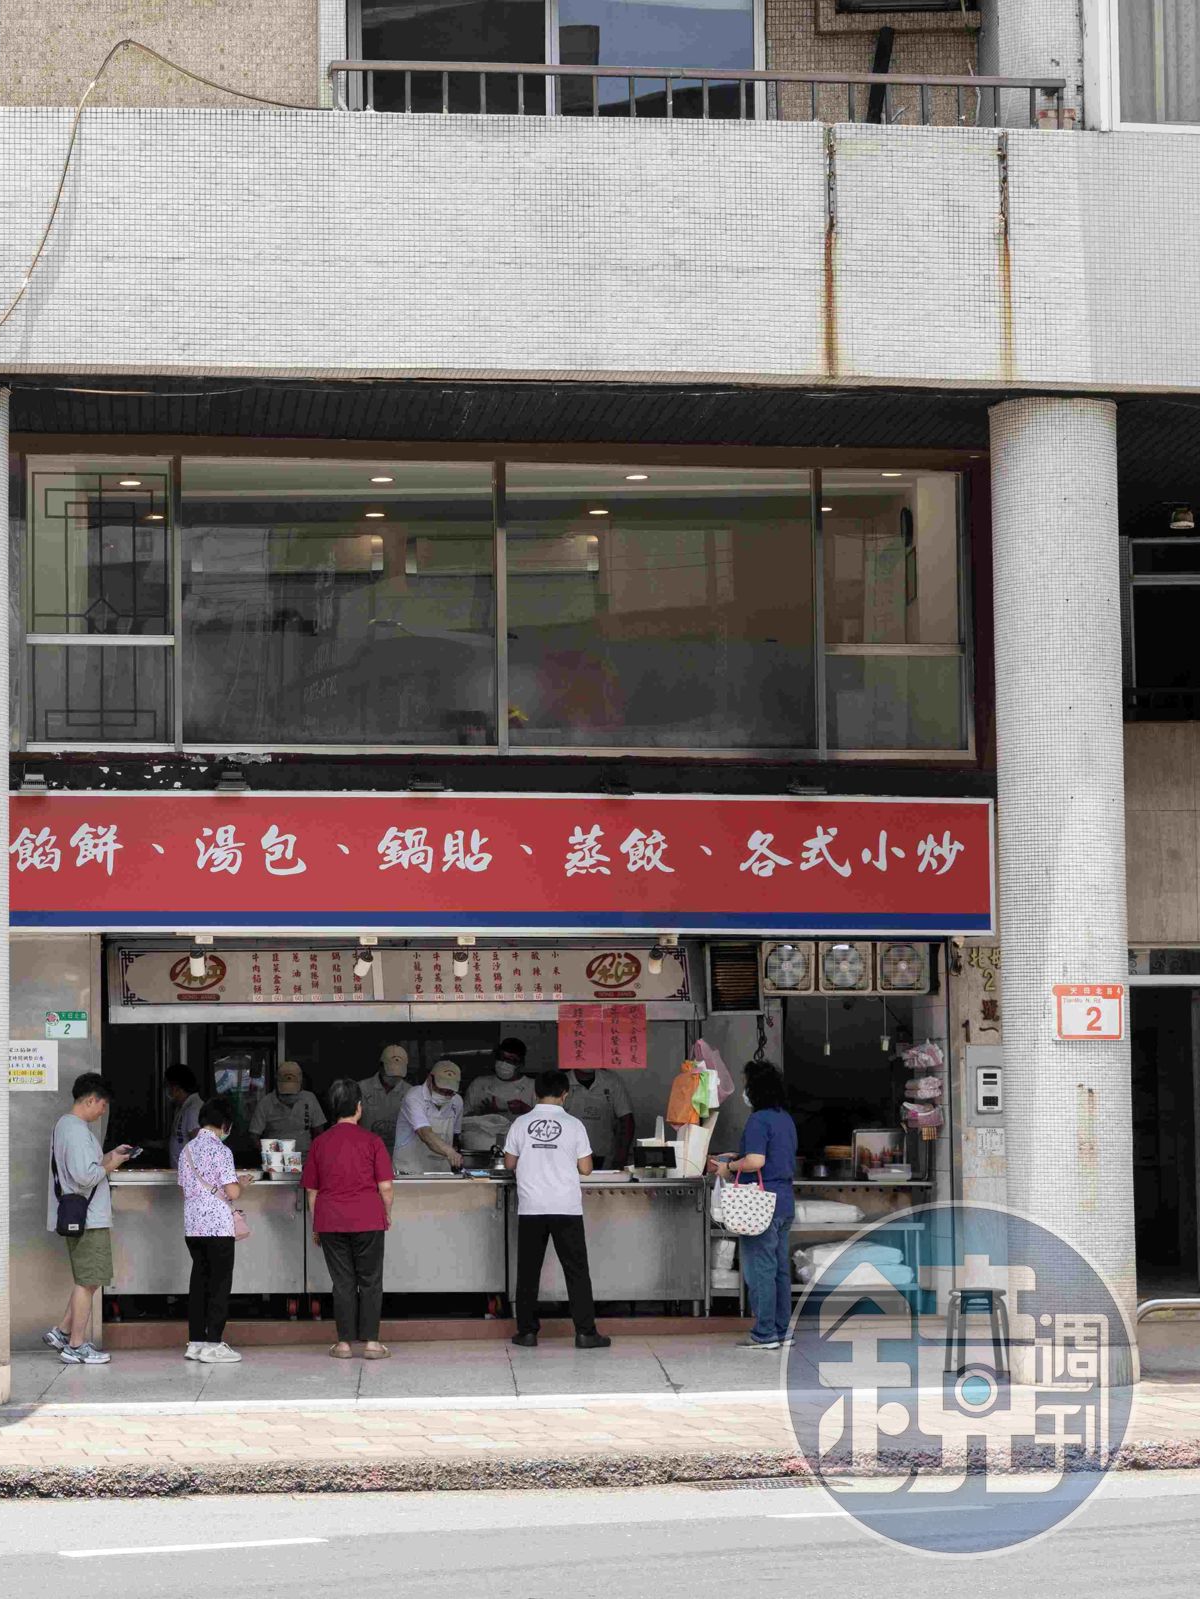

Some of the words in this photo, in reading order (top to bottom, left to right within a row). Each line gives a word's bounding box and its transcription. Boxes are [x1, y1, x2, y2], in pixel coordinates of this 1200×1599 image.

[983, 968, 996, 992] 2
[64, 1023, 71, 1035] 2
[1086, 1006, 1103, 1032] 2
